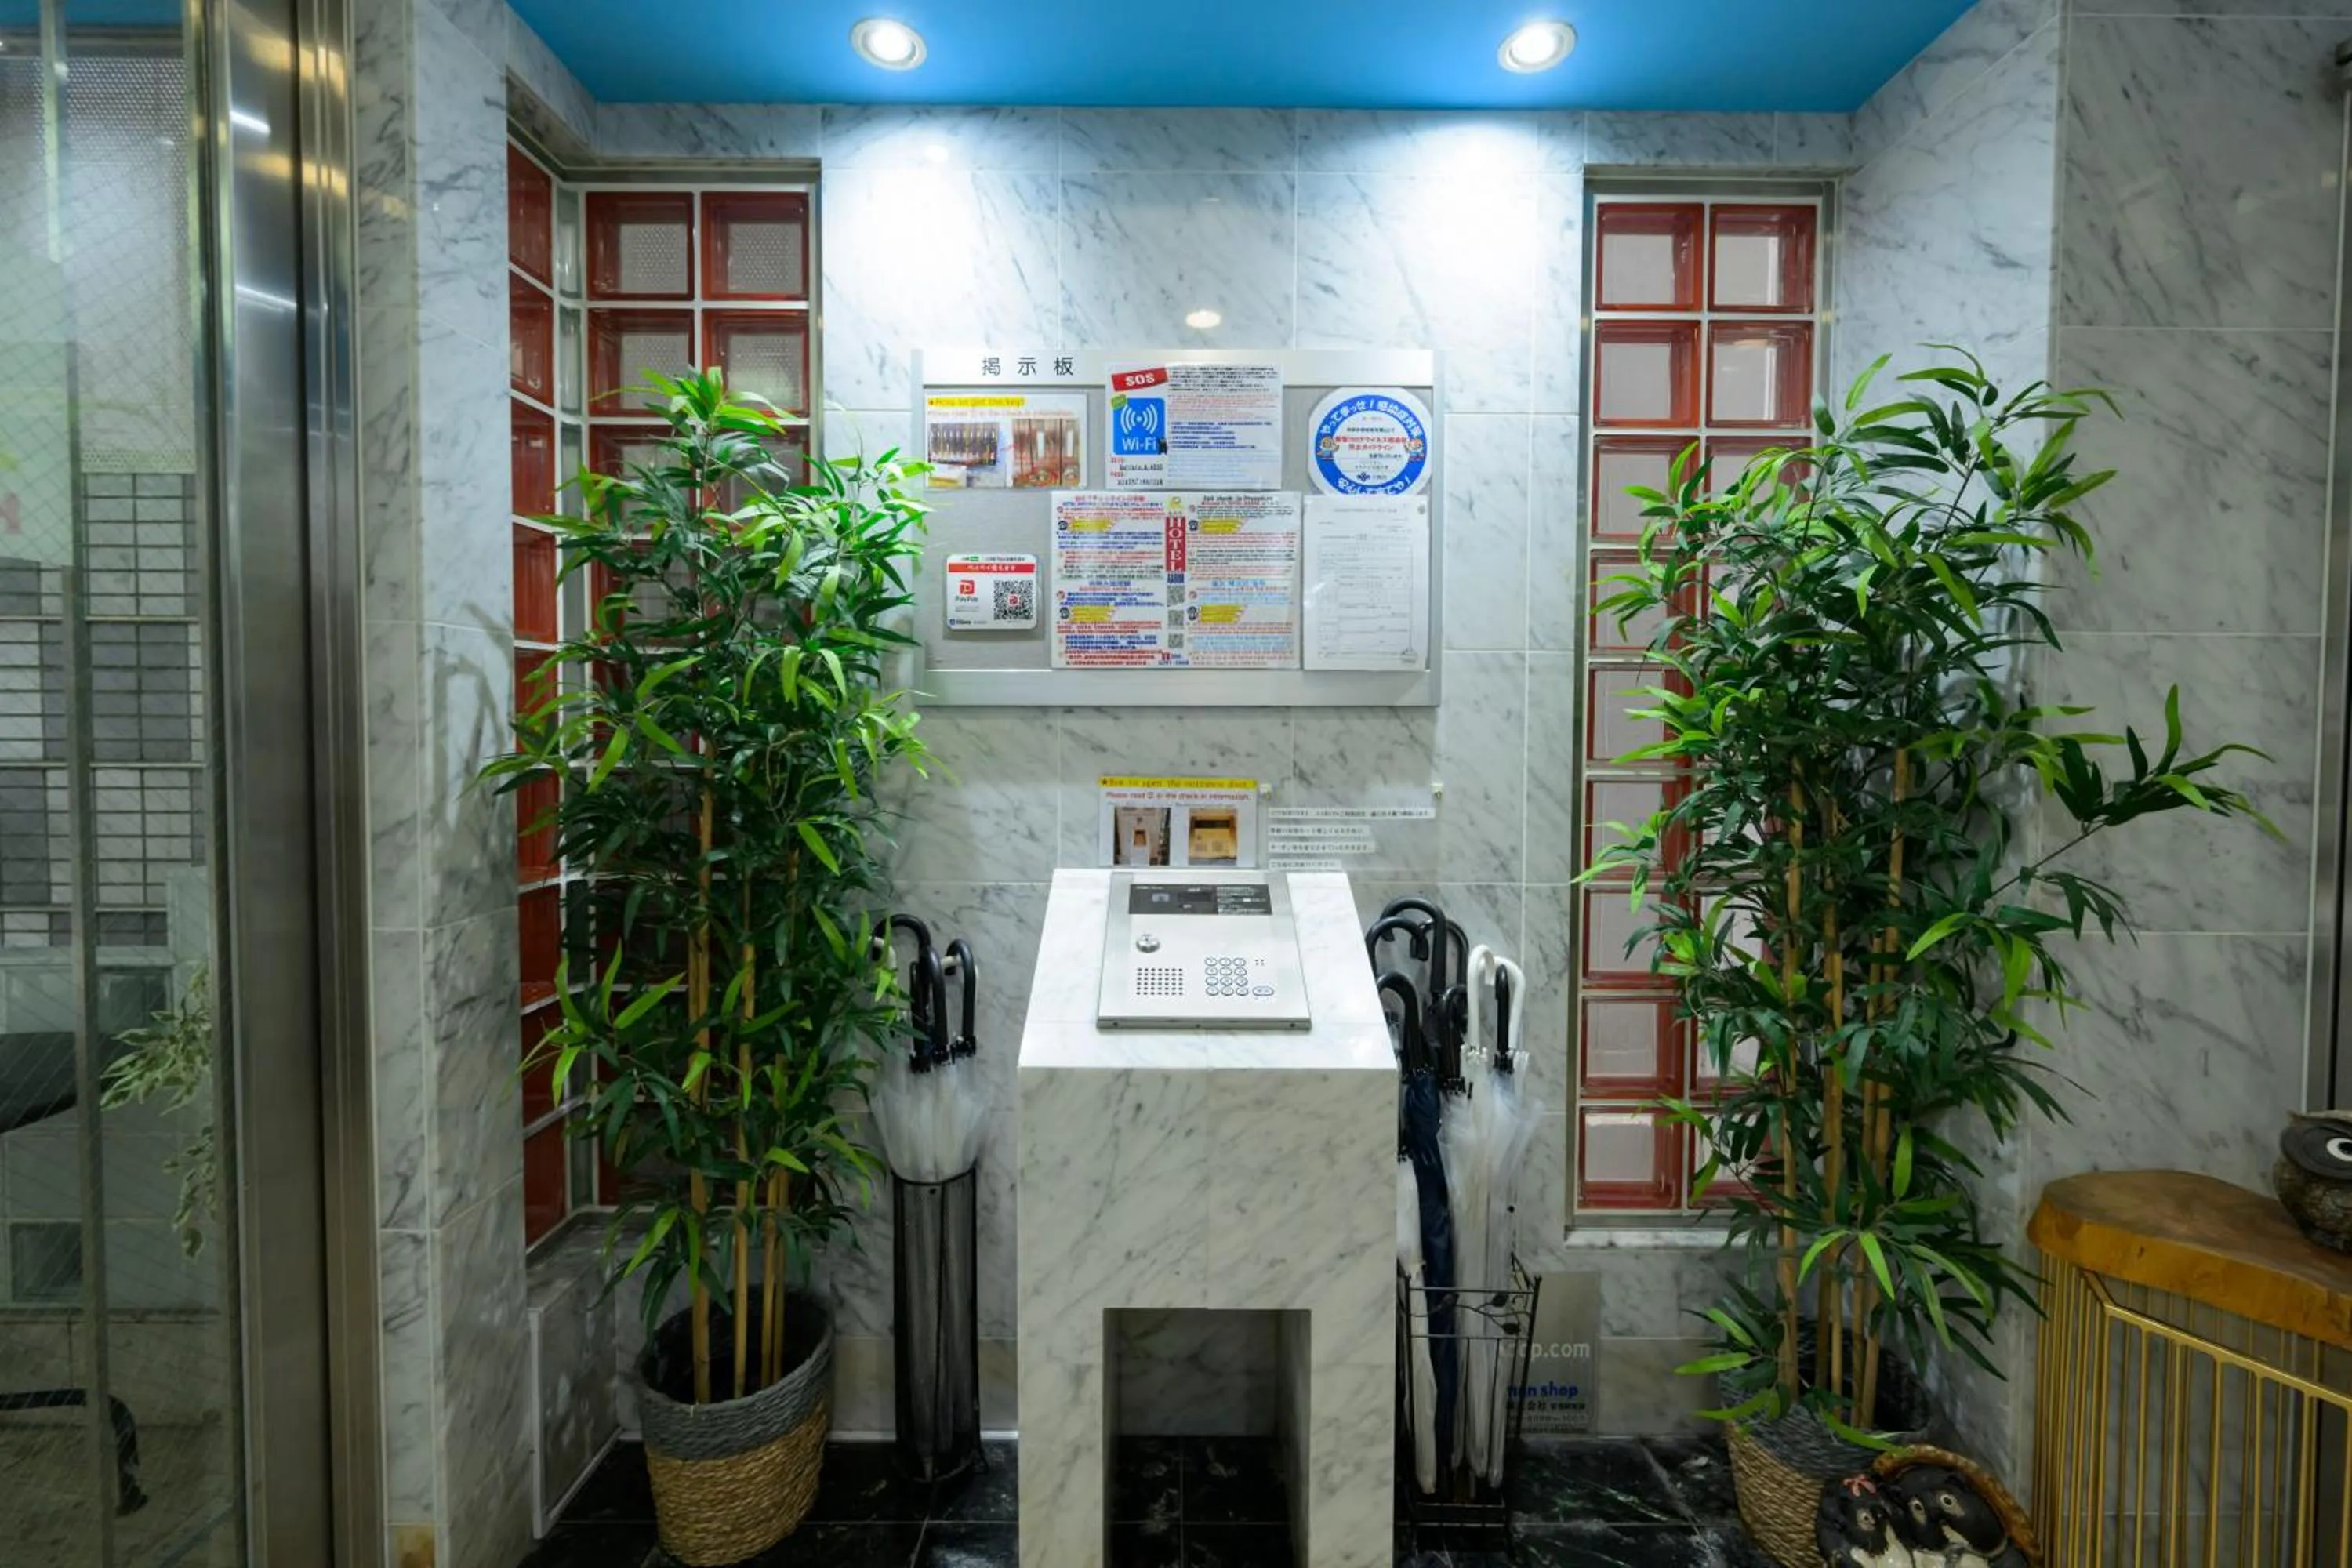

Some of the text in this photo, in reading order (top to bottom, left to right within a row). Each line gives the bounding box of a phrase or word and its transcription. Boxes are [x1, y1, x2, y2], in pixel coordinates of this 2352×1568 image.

[982, 357, 1074, 376] 掲示板
[1125, 372, 1155, 387] SOS
[1122, 437, 1157, 451] Wi-Fi
[1169, 514, 1183, 571] HOTEL
[1541, 1380, 1579, 1399] shop
